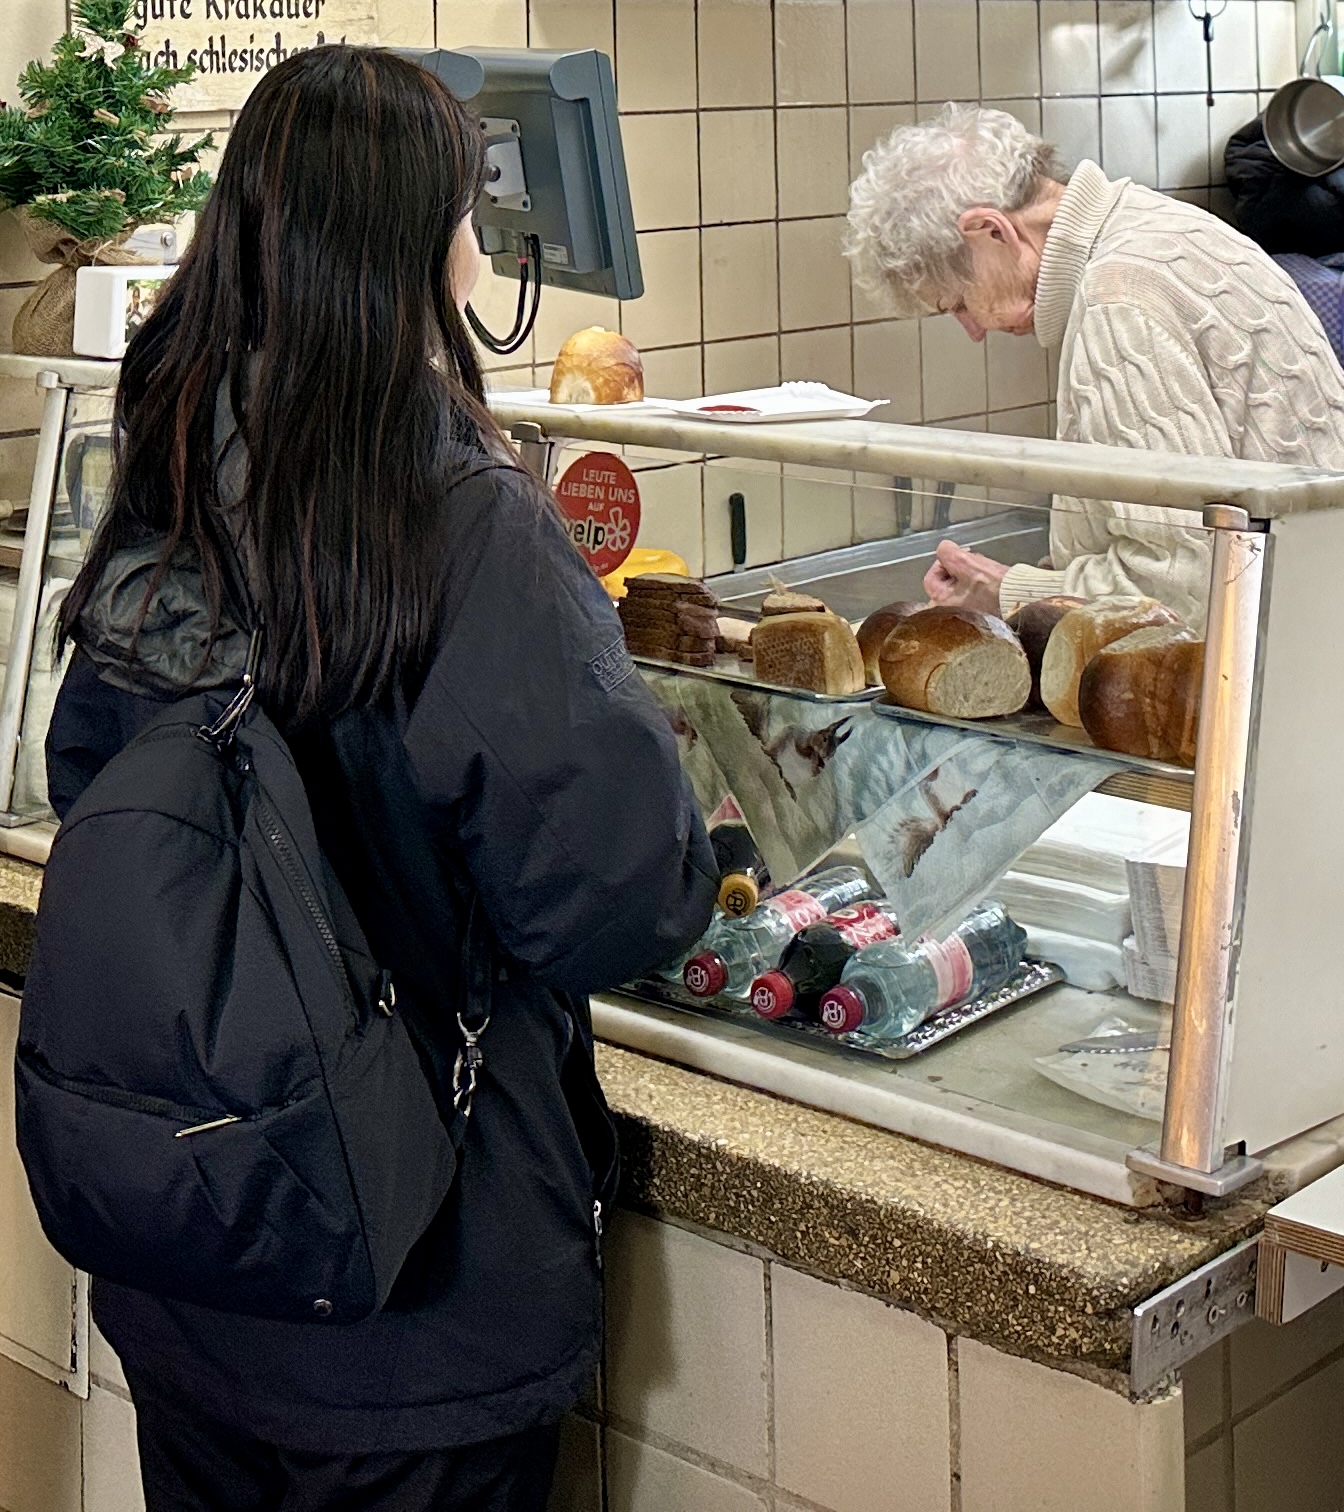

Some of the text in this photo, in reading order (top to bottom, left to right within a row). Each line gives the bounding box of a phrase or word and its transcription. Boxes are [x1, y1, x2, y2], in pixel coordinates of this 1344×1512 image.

[582, 468, 617, 485] LEUTE
[561, 481, 636, 504] LIEBEN UNS
[587, 502, 605, 512] AUF
